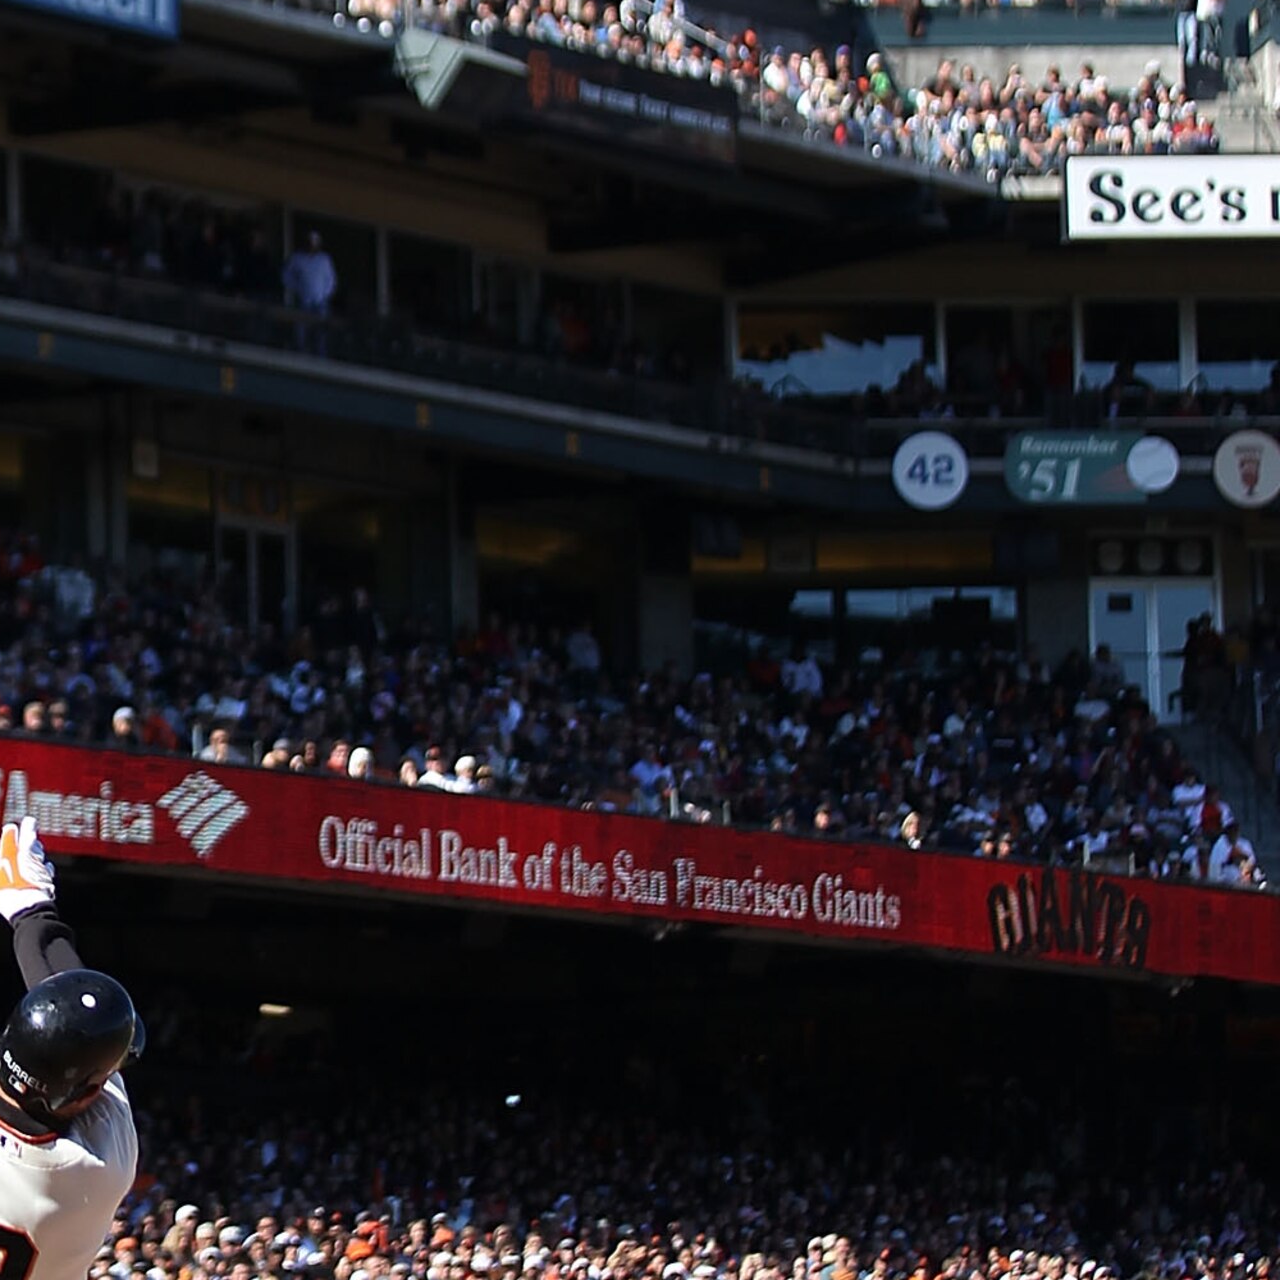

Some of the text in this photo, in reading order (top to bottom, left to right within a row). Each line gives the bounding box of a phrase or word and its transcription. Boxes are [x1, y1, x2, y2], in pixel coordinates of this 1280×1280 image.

[1089, 171, 1247, 222] See's
[907, 453, 954, 484] 42
[3, 770, 154, 843] America
[319, 815, 901, 929] Official Bank of the San Francisco Giants
[987, 867, 1152, 970] GIANTS
[3, 1049, 48, 1094] BURRELL
